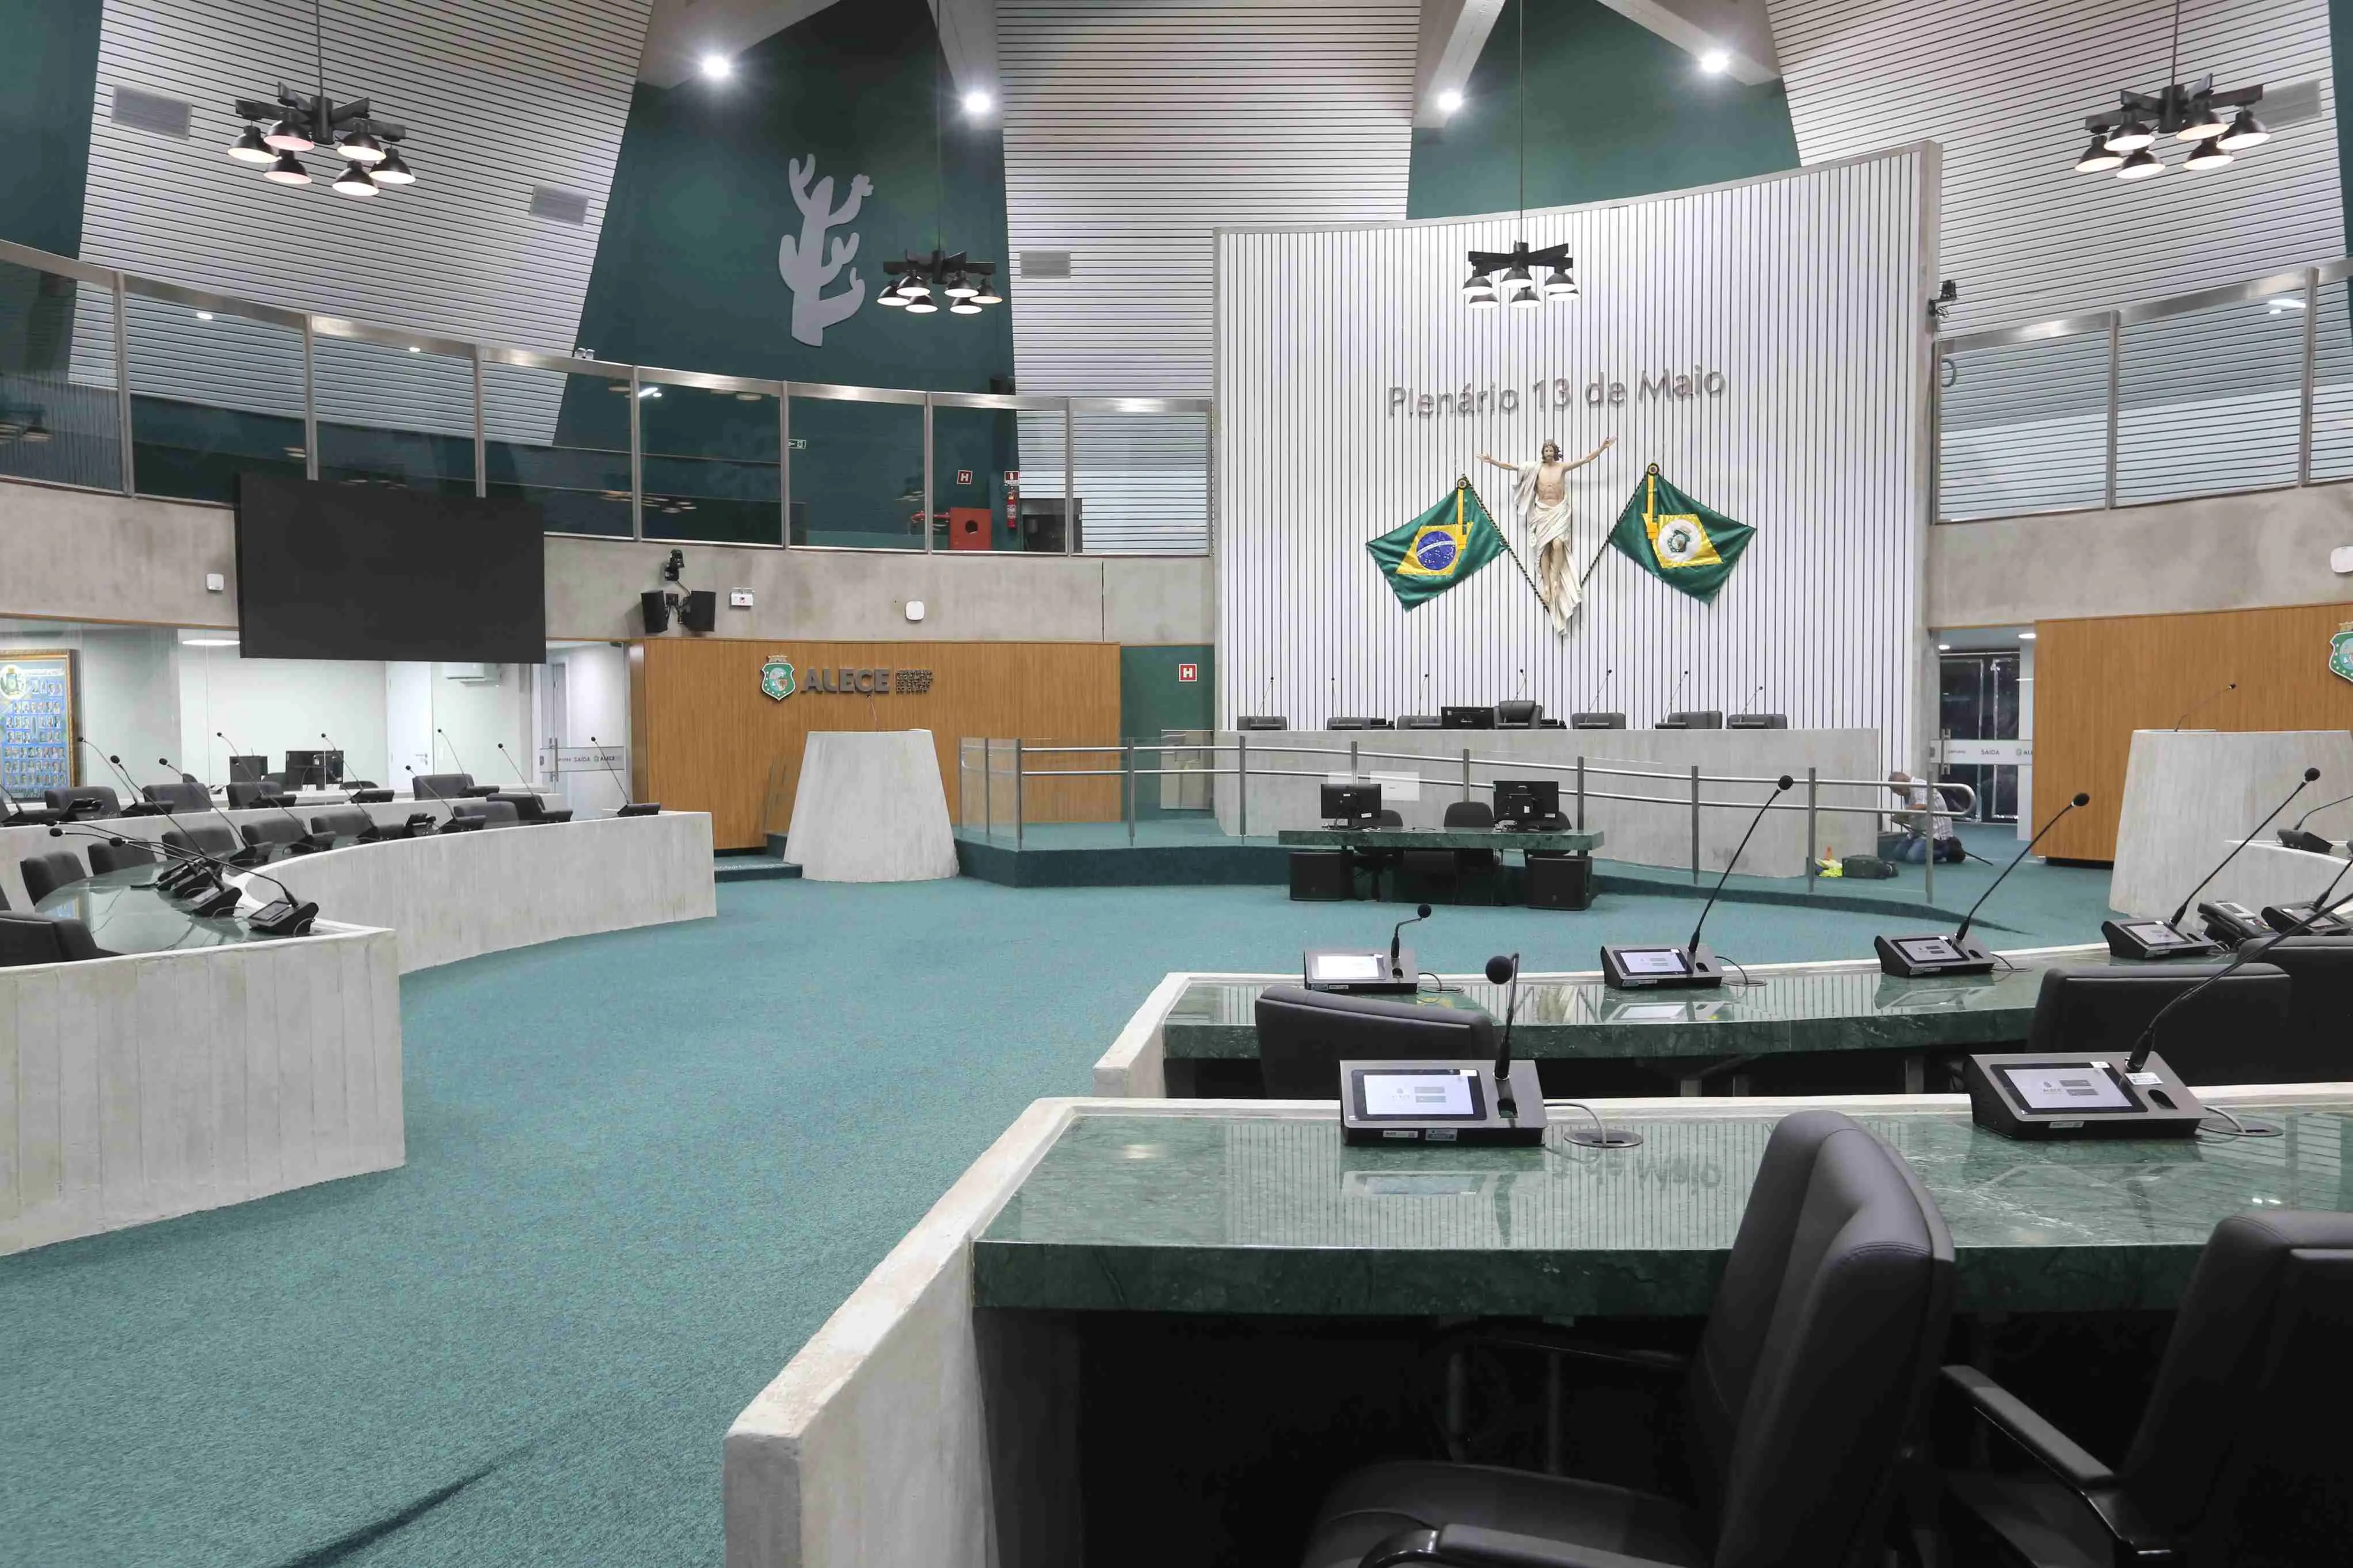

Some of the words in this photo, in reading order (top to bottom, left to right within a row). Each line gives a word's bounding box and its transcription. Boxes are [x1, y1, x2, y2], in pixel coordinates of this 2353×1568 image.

[1389, 381, 1519, 415] Plenário
[1532, 377, 1571, 411] 13
[1585, 371, 1625, 406] de
[1638, 364, 1726, 403] Maio
[801, 668, 889, 694] ALECE
